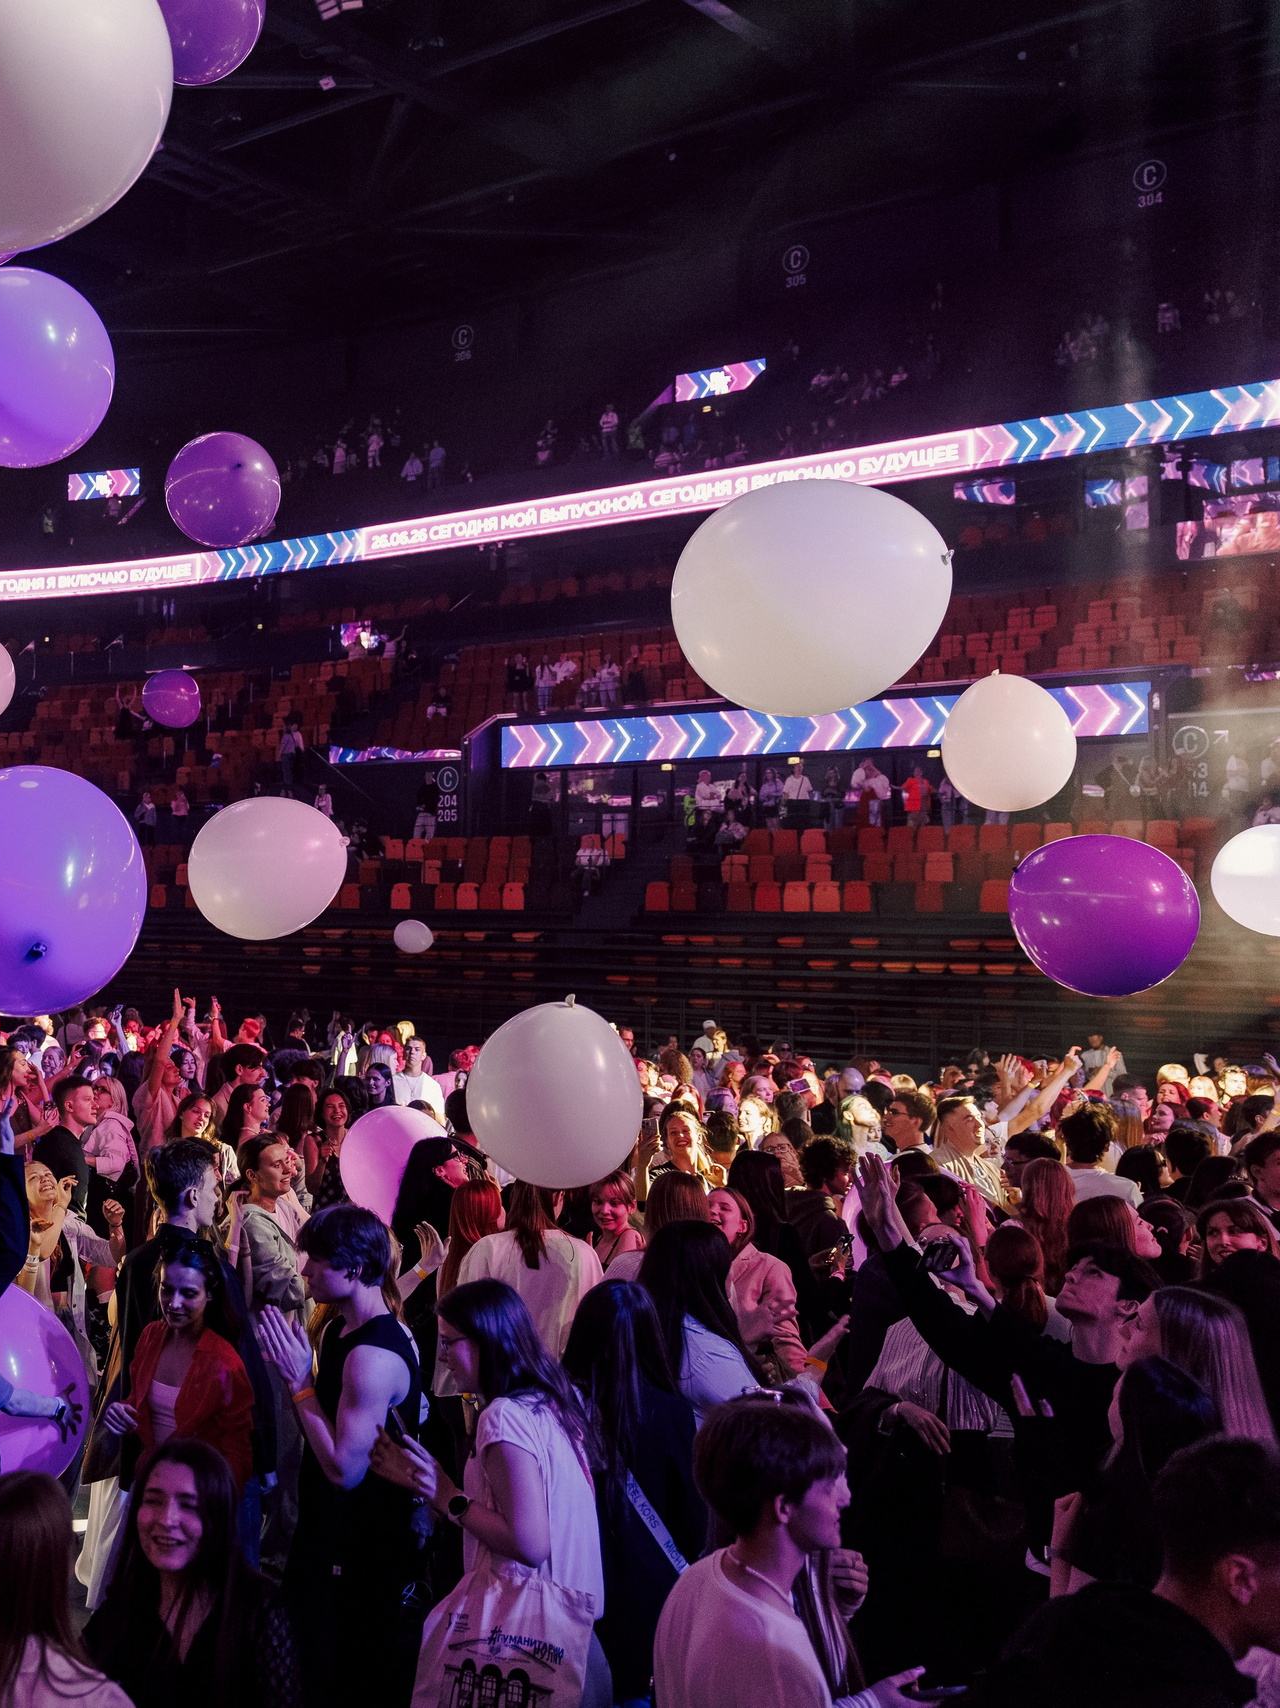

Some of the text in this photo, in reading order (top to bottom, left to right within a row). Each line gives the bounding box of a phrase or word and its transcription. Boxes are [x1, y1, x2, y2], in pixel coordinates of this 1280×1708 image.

[1143, 165, 1157, 186] C
[1137, 191, 1163, 208] 304
[790, 250, 802, 269] C
[785, 274, 807, 289] 305
[429, 516, 498, 541] СЕГОДНЯ
[501, 508, 538, 530] МОЙ
[540, 490, 647, 524] ВЫПУСКНОЙ.
[649, 480, 733, 507] СЕГОДНЯ
[734, 477, 748, 494] Я
[858, 443, 959, 475] БУДУЩЕЕ
[46, 576, 56, 589] Я
[57, 570, 129, 589] ВКЛЮЧАЮ
[130, 562, 192, 583] БУДУЩЕЕ
[443, 771, 453, 788] C
[437, 794, 458, 808] 204
[437, 809, 458, 822] 205
[639, 1501, 660, 1529] KORS
